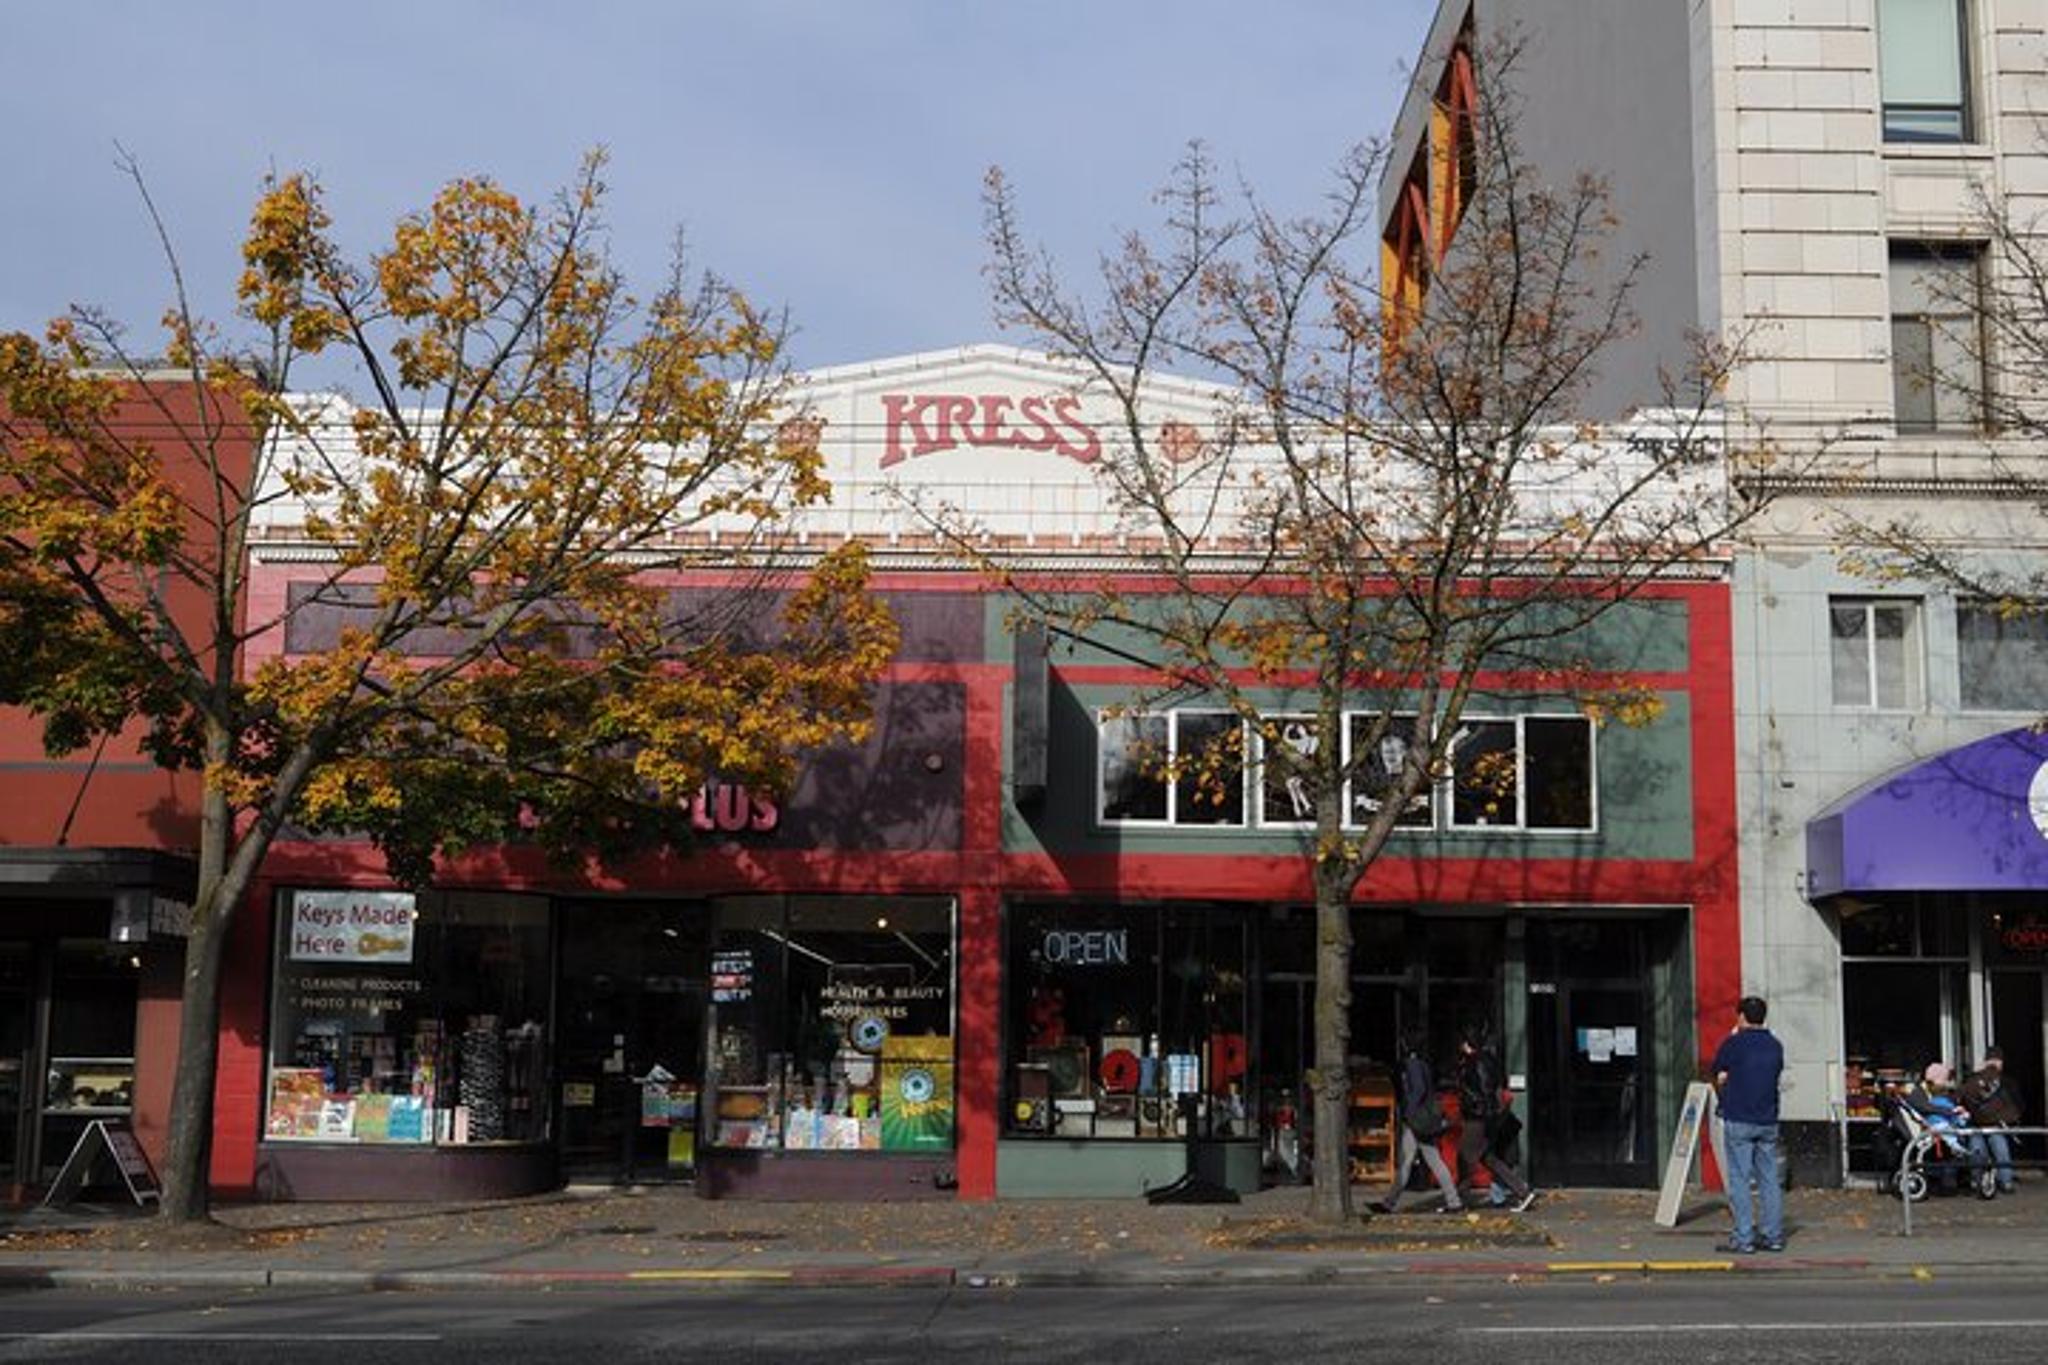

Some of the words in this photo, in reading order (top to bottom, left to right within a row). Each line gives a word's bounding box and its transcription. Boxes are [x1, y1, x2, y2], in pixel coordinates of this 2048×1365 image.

[879, 394, 1101, 468] KRESS
[297, 903, 345, 927] Keys
[349, 904, 407, 924] Made
[296, 932, 345, 953] Here
[1044, 931, 1128, 964] OPEN
[361, 979, 421, 992] PRODUCTS
[893, 986, 944, 999] BEAUTY
[301, 999, 345, 1010] PHOTO
